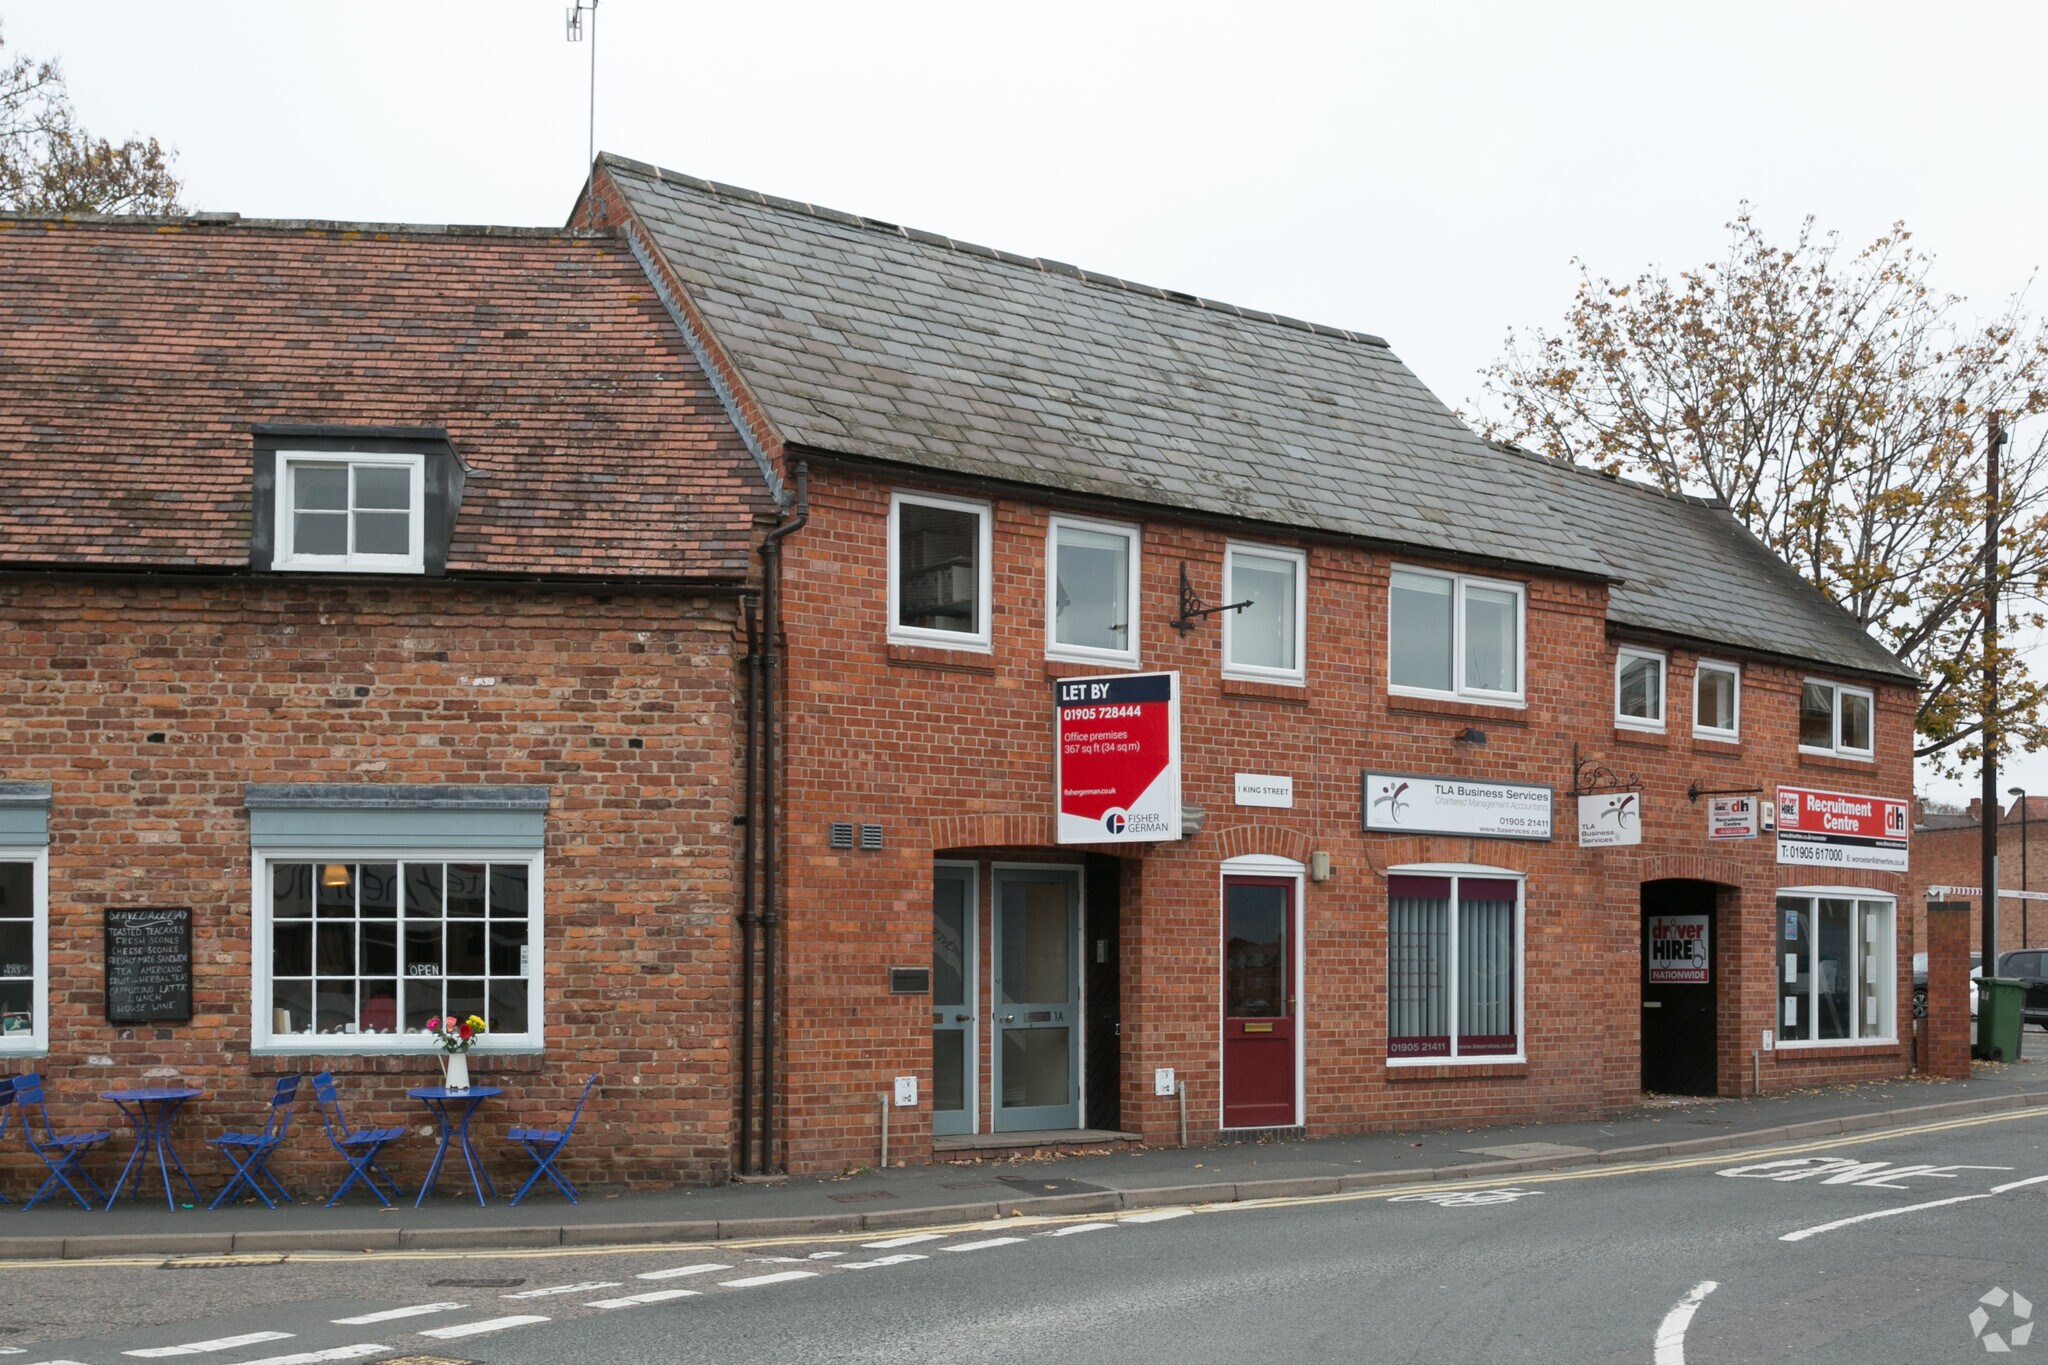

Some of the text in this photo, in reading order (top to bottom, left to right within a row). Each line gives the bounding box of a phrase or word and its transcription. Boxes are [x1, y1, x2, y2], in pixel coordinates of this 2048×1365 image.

[1062, 683, 1110, 701] LET BY
[1064, 705, 1141, 720] 01905 728444
[1064, 730, 1128, 742] Office premises
[1064, 741, 1141, 754] 367 sq ft (34 sq m)
[1243, 786, 1261, 794] KING
[1263, 787, 1289, 795] STREET
[1434, 784, 1549, 802] TLA Business Services
[1434, 795, 1467, 807] Chartered
[1468, 797, 1509, 811] Management
[1731, 799, 1749, 813] dh
[1806, 794, 1872, 817] Recruitment
[1781, 804, 1794, 815] HIRE
[1128, 813, 1160, 824] FISHER
[1499, 817, 1549, 828] 01905 21411
[1823, 813, 1859, 832] Centre
[1887, 806, 1904, 831] dh
[1128, 822, 1169, 833] GERMAN
[1582, 836, 1613, 844] Services
[1781, 845, 1843, 862] T: 01905 617000
[108, 911, 188, 920] SERVED ALL DAY
[108, 925, 184, 937] TOASTED TEACAKES
[1652, 917, 1704, 940] driver
[115, 936, 179, 945] FRESH SCONES
[112, 945, 179, 956] CHEESE SCONES
[1653, 939, 1692, 960] HIRE
[108, 956, 137, 965] FRESHLY
[137, 955, 155, 964] MADE
[114, 965, 182, 975] TEA AMERICANO
[410, 964, 439, 976] OPEN
[1653, 970, 1705, 979] NATIONWIDE
[159, 984, 188, 993] LATTE
[128, 994, 162, 1003] LUNCH
[117, 1001, 176, 1013] HOUSE WINE
[1054, 1011, 1064, 1022] 1A
[1391, 1042, 1446, 1052] 01905 21411
